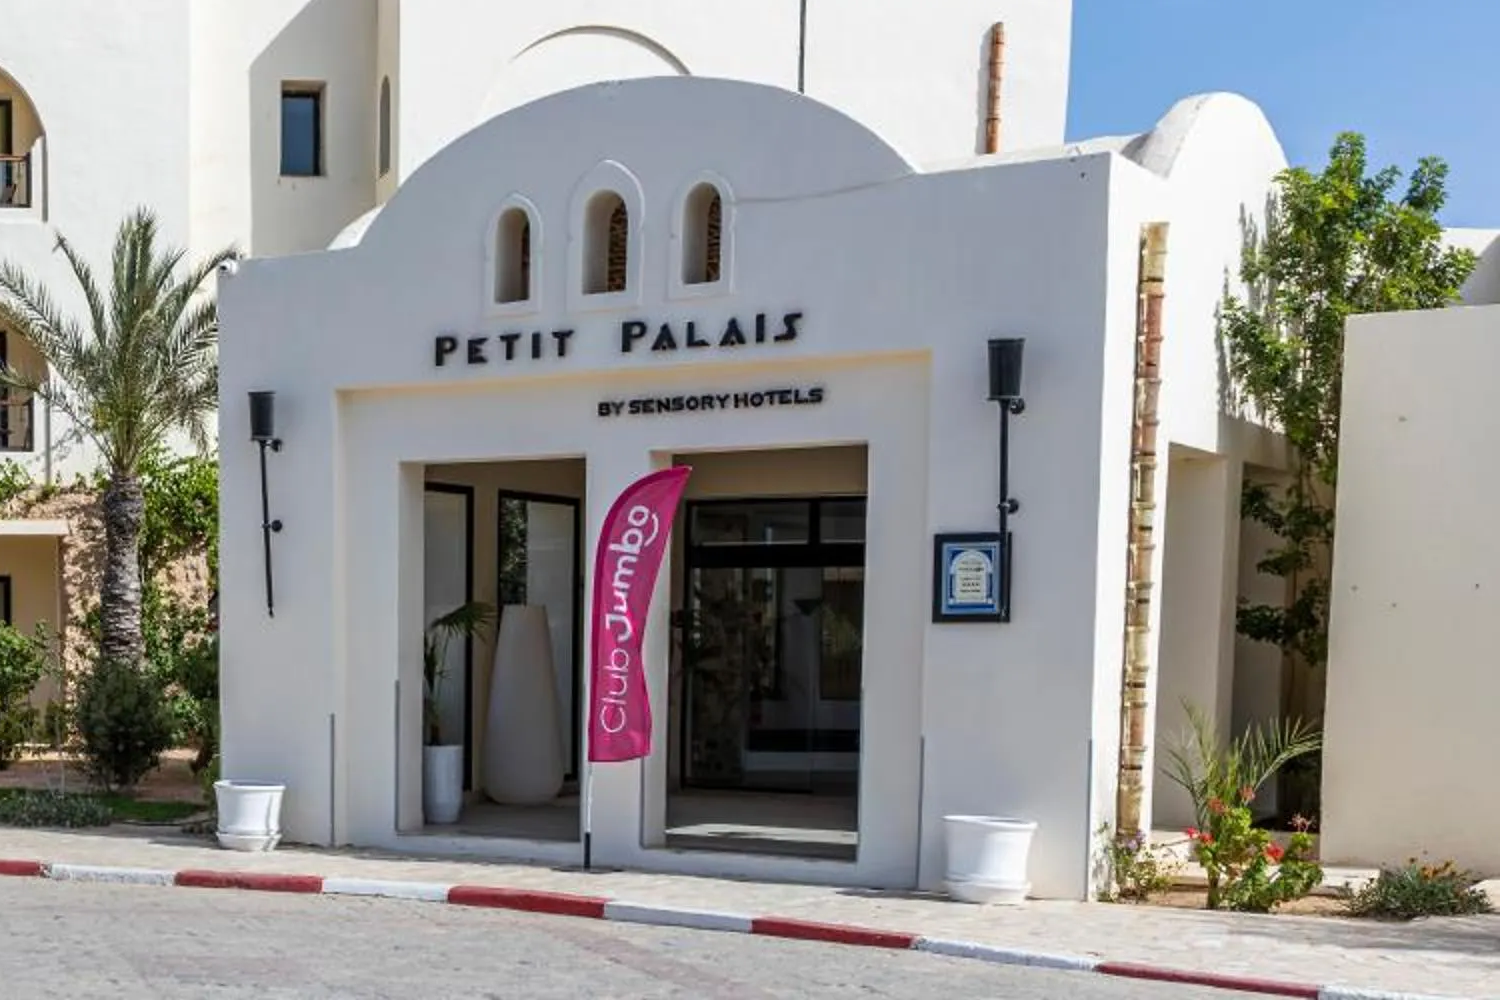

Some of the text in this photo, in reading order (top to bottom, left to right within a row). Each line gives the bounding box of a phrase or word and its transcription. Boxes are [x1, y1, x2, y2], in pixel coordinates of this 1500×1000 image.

[434, 312, 803, 367] PETIT PALAIS
[597, 387, 825, 417] BY SENSORY HOTELS
[599, 504, 651, 734] Club Jumbo
